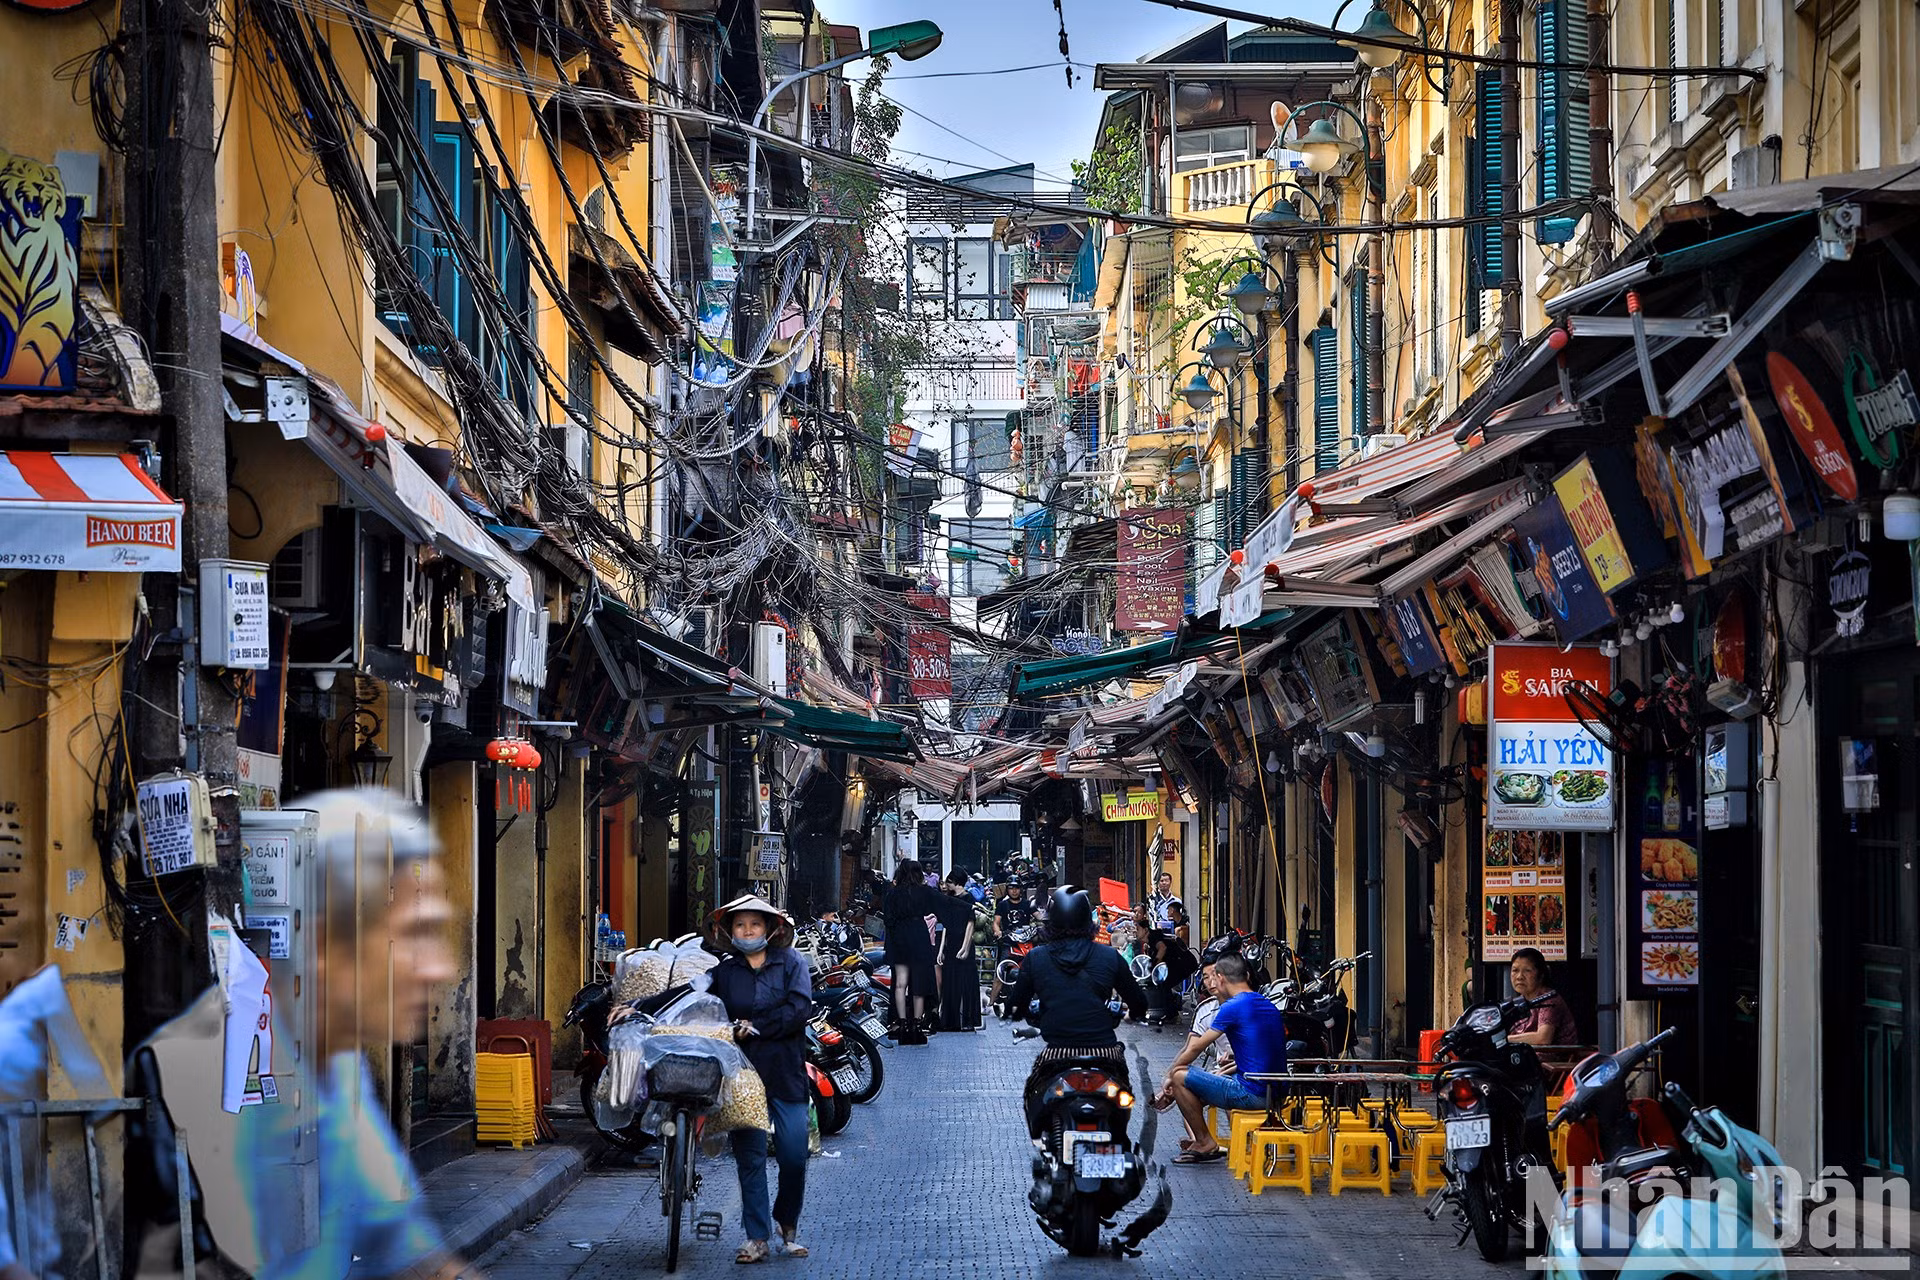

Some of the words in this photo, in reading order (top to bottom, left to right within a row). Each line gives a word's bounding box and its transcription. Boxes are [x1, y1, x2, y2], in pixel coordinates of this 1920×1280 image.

[1814, 450, 1848, 476] SAIGON
[90, 519, 134, 543] HANOI
[138, 521, 173, 545] BEER
[1142, 516, 1181, 540] Spa
[20, 555, 40, 564] 932
[43, 555, 65, 565] 678
[1552, 550, 1576, 579] BEER
[1136, 585, 1177, 593] Waxing
[913, 658, 949, 679] 30-50%
[1550, 668, 1574, 678] BIA
[1500, 730, 1548, 765] HẢI
[1553, 728, 1605, 765] YẾN
[140, 788, 161, 822] SỬA
[164, 786, 188, 818] NHÀ
[256, 843, 278, 858] GẦN
